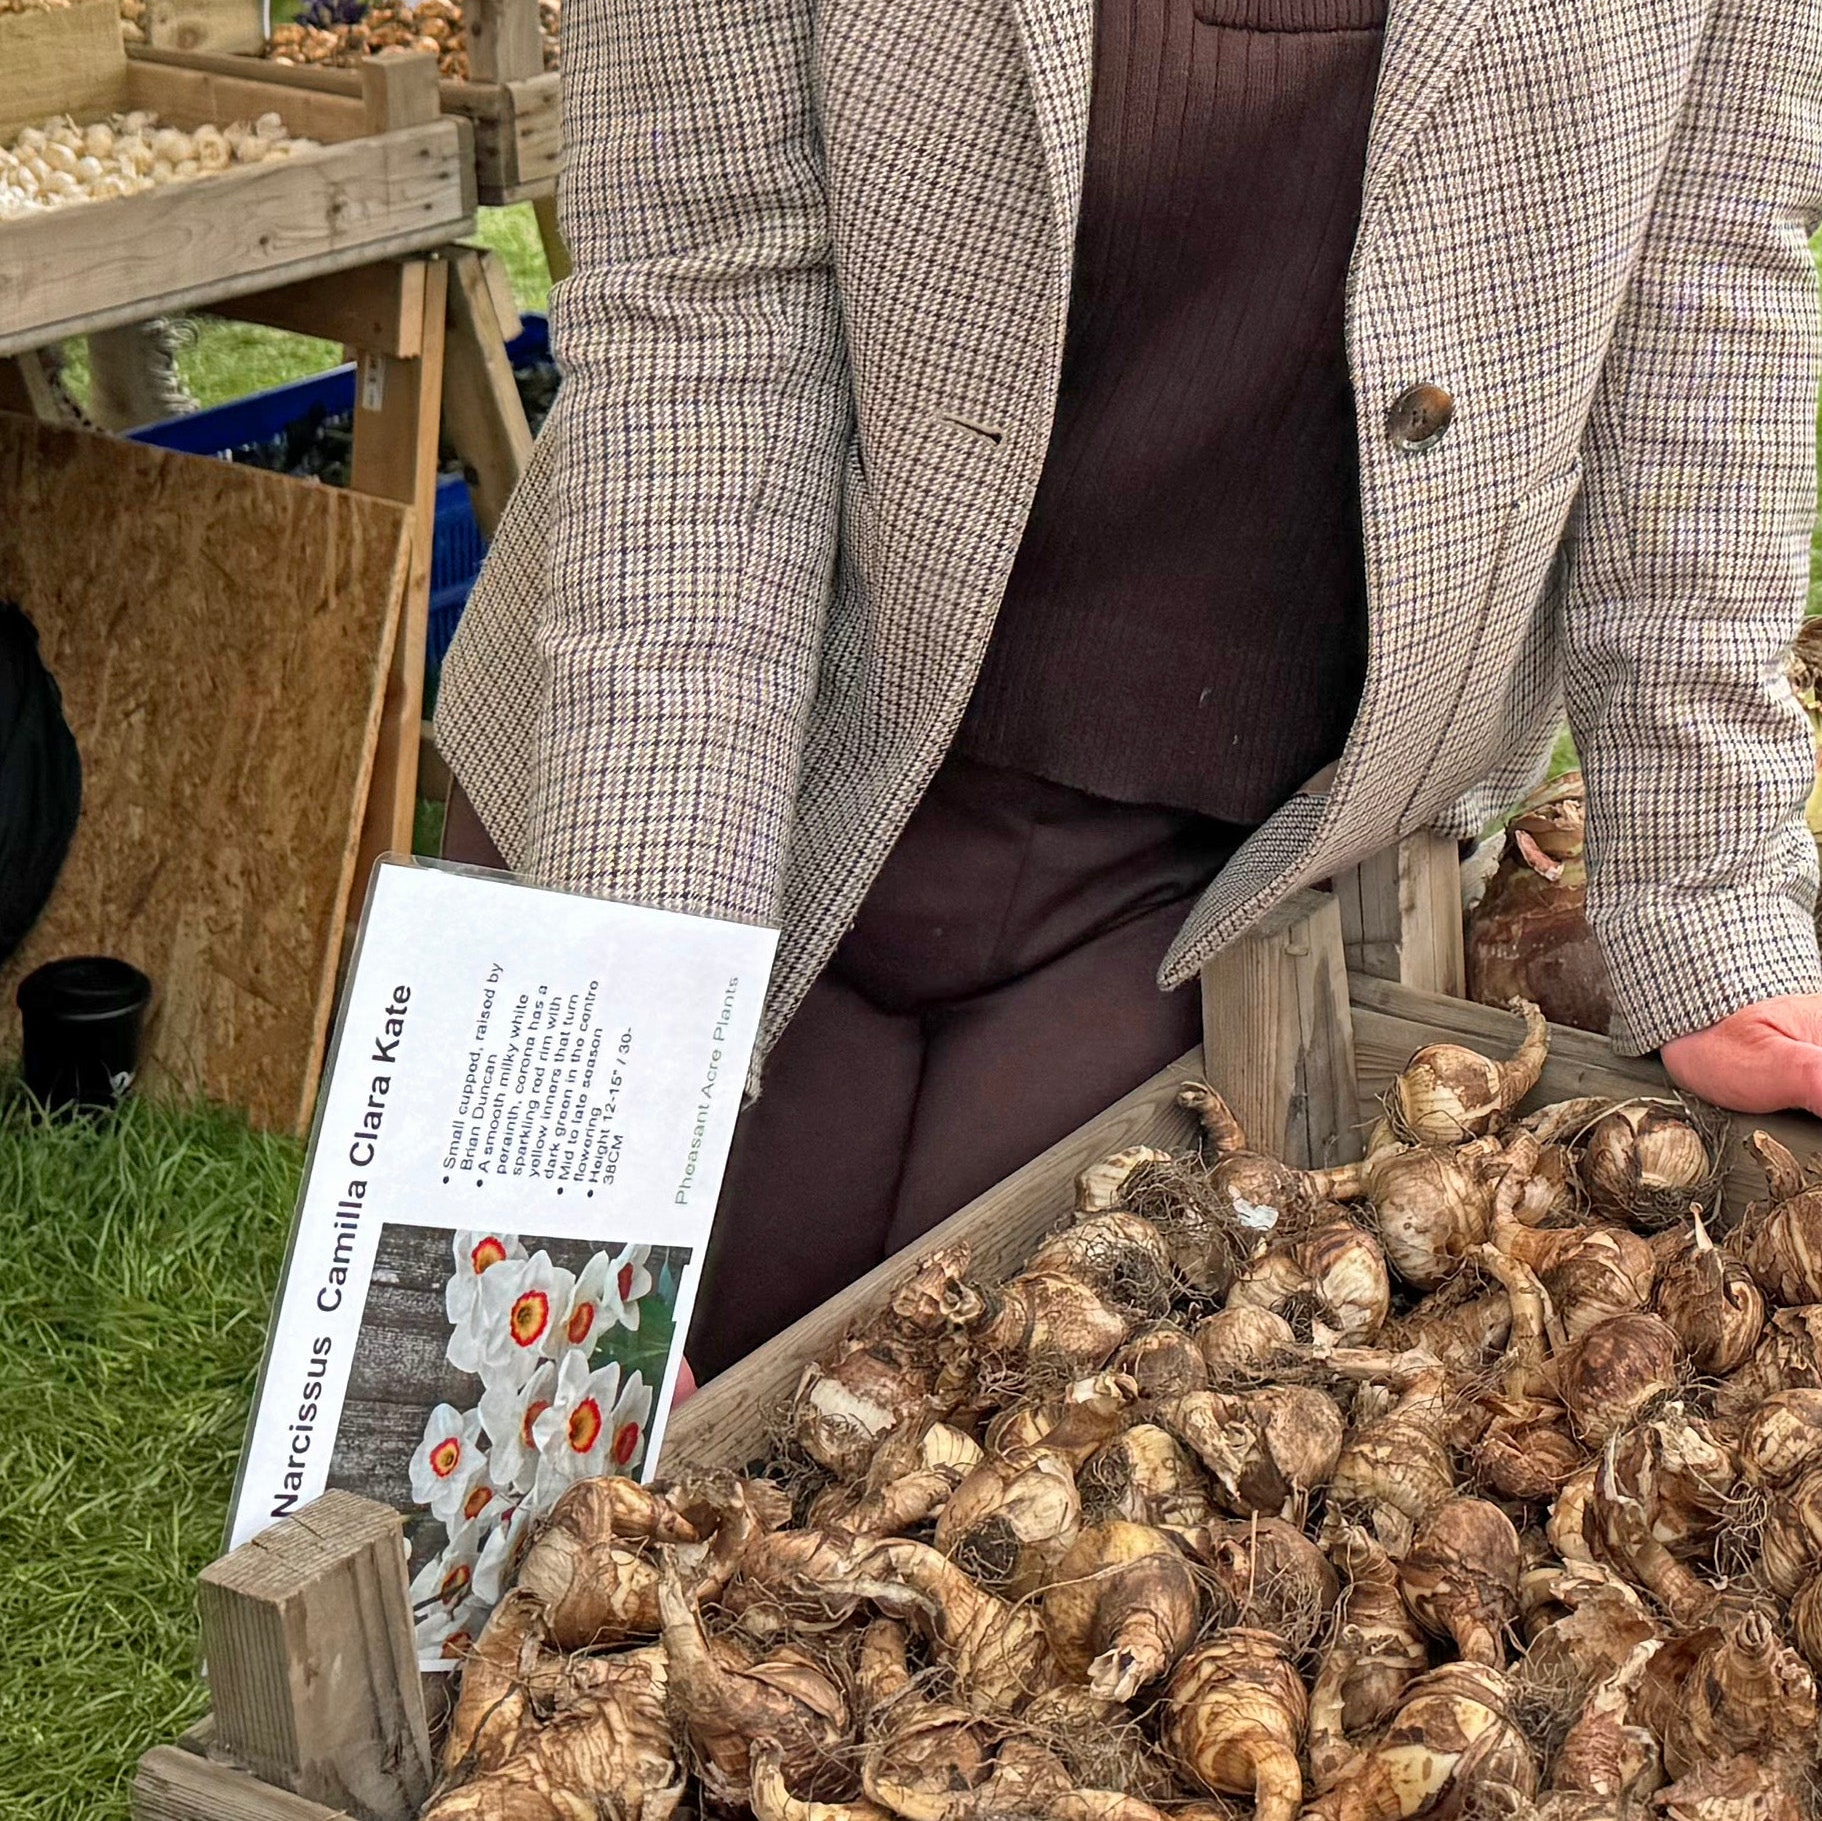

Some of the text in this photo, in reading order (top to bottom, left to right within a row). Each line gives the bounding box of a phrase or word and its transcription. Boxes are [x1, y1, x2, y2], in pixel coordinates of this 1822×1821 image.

[475, 988, 496, 1041] raised
[485, 962, 504, 983] by
[477, 993, 529, 1174] A smooth milky white
[512, 996, 562, 1176] sparkling red rim with
[514, 1036, 536, 1095] corona
[526, 1000, 545, 1031] has
[538, 985, 548, 996] a
[528, 994, 580, 1178] yellow inners that turn
[544, 980, 599, 1180] dark green in the centre
[674, 976, 740, 1206] Pheasant Acre Plants
[442, 1120, 465, 1170] Small
[459, 1054, 498, 1171] Brian Duncan
[557, 1027, 604, 1181] Mid to late season
[573, 1106, 603, 1182] flowering
[588, 1129, 611, 1183] Height
[615, 1057, 627, 1066] /
[602, 1134, 624, 1186] 38CM
[269, 984, 412, 1519] Narcissus Camilla Clara Kate
